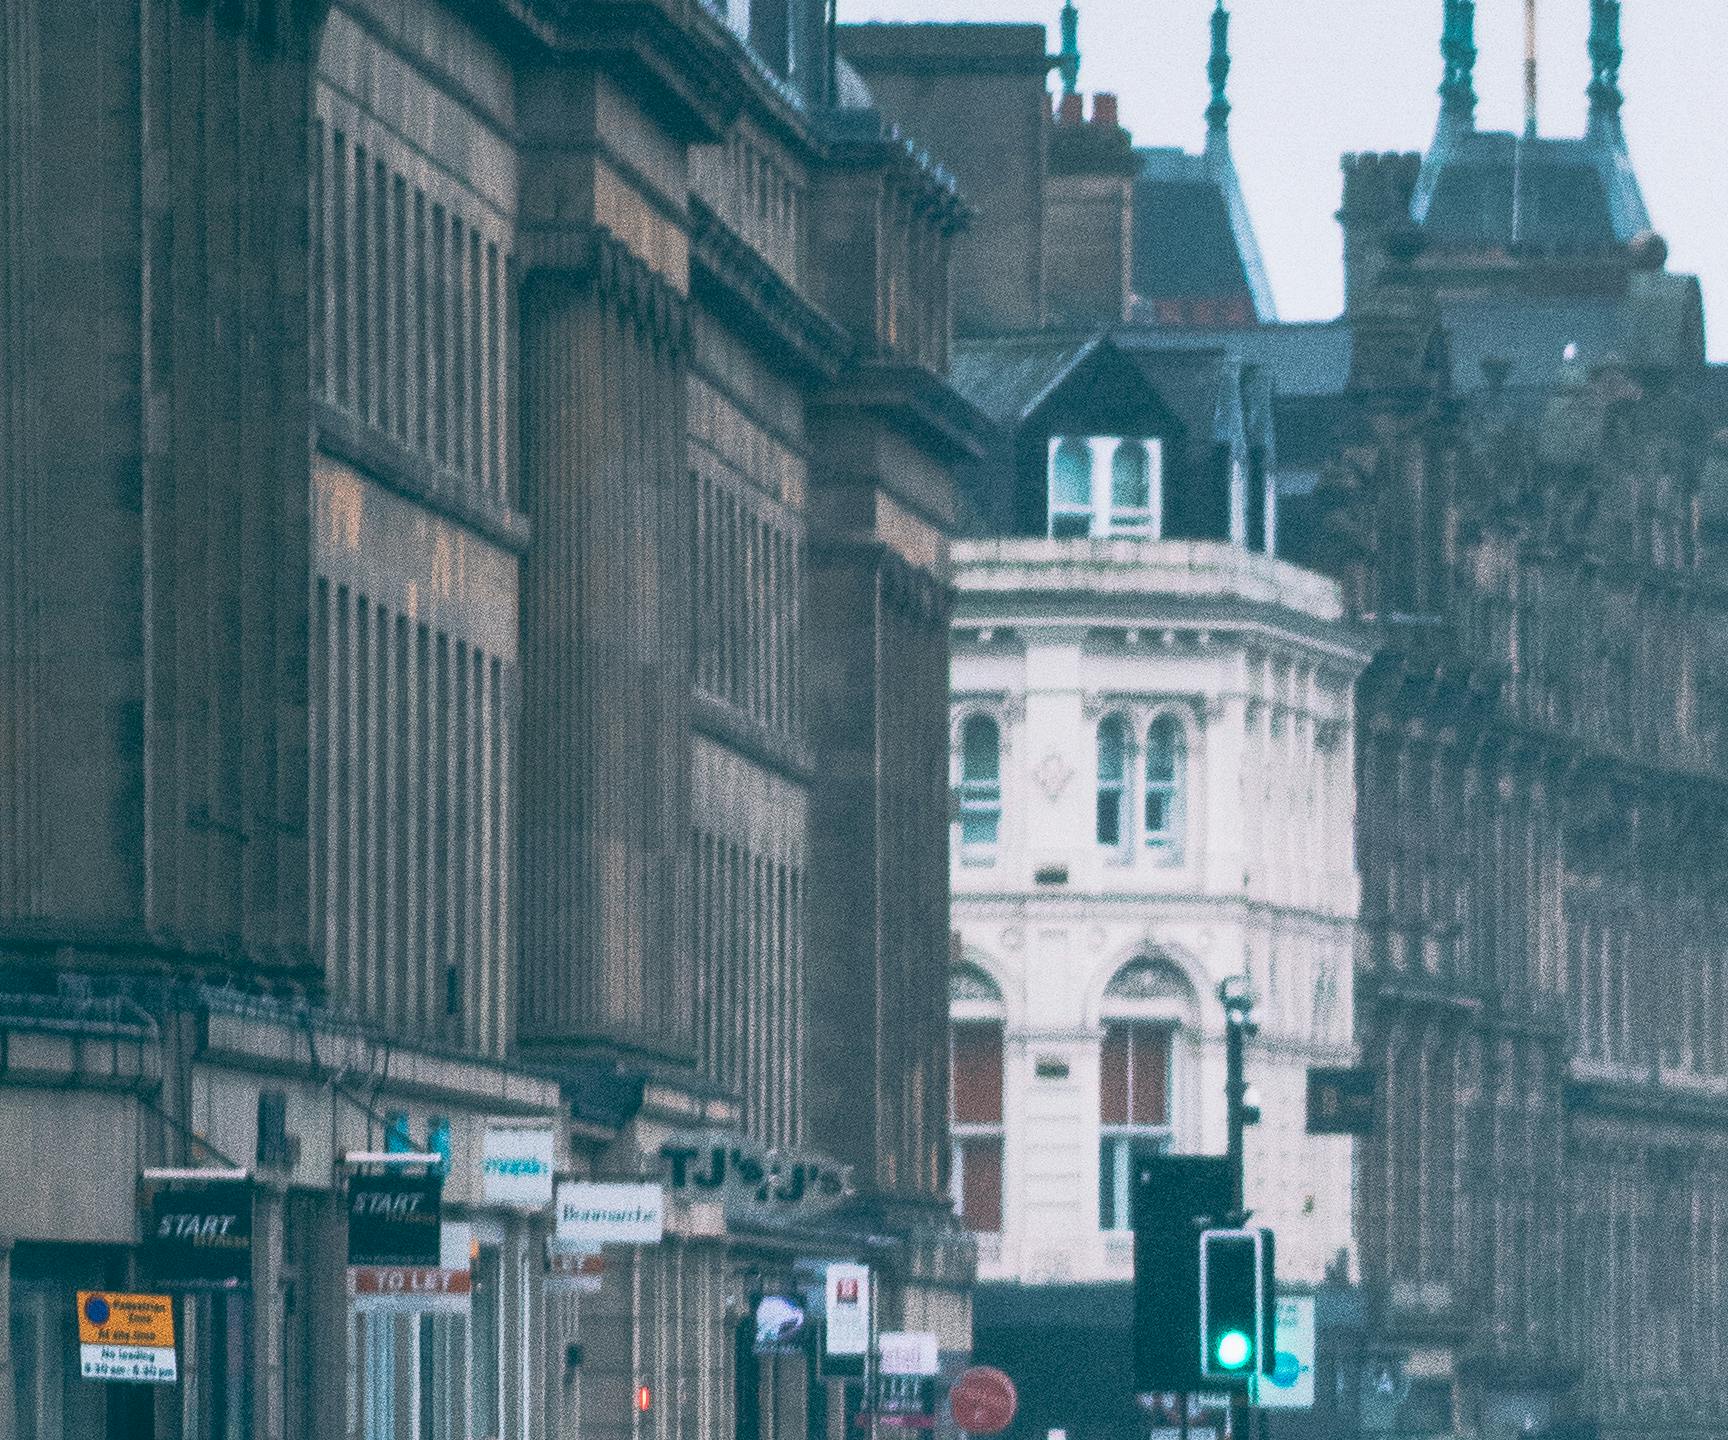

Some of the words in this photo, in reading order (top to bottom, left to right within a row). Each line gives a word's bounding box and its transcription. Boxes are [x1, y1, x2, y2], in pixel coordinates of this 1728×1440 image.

[353, 1192, 424, 1214] START
[157, 1213, 237, 1239] START
[101, 1348, 116, 1359] No
[118, 1349, 156, 1363] loading
